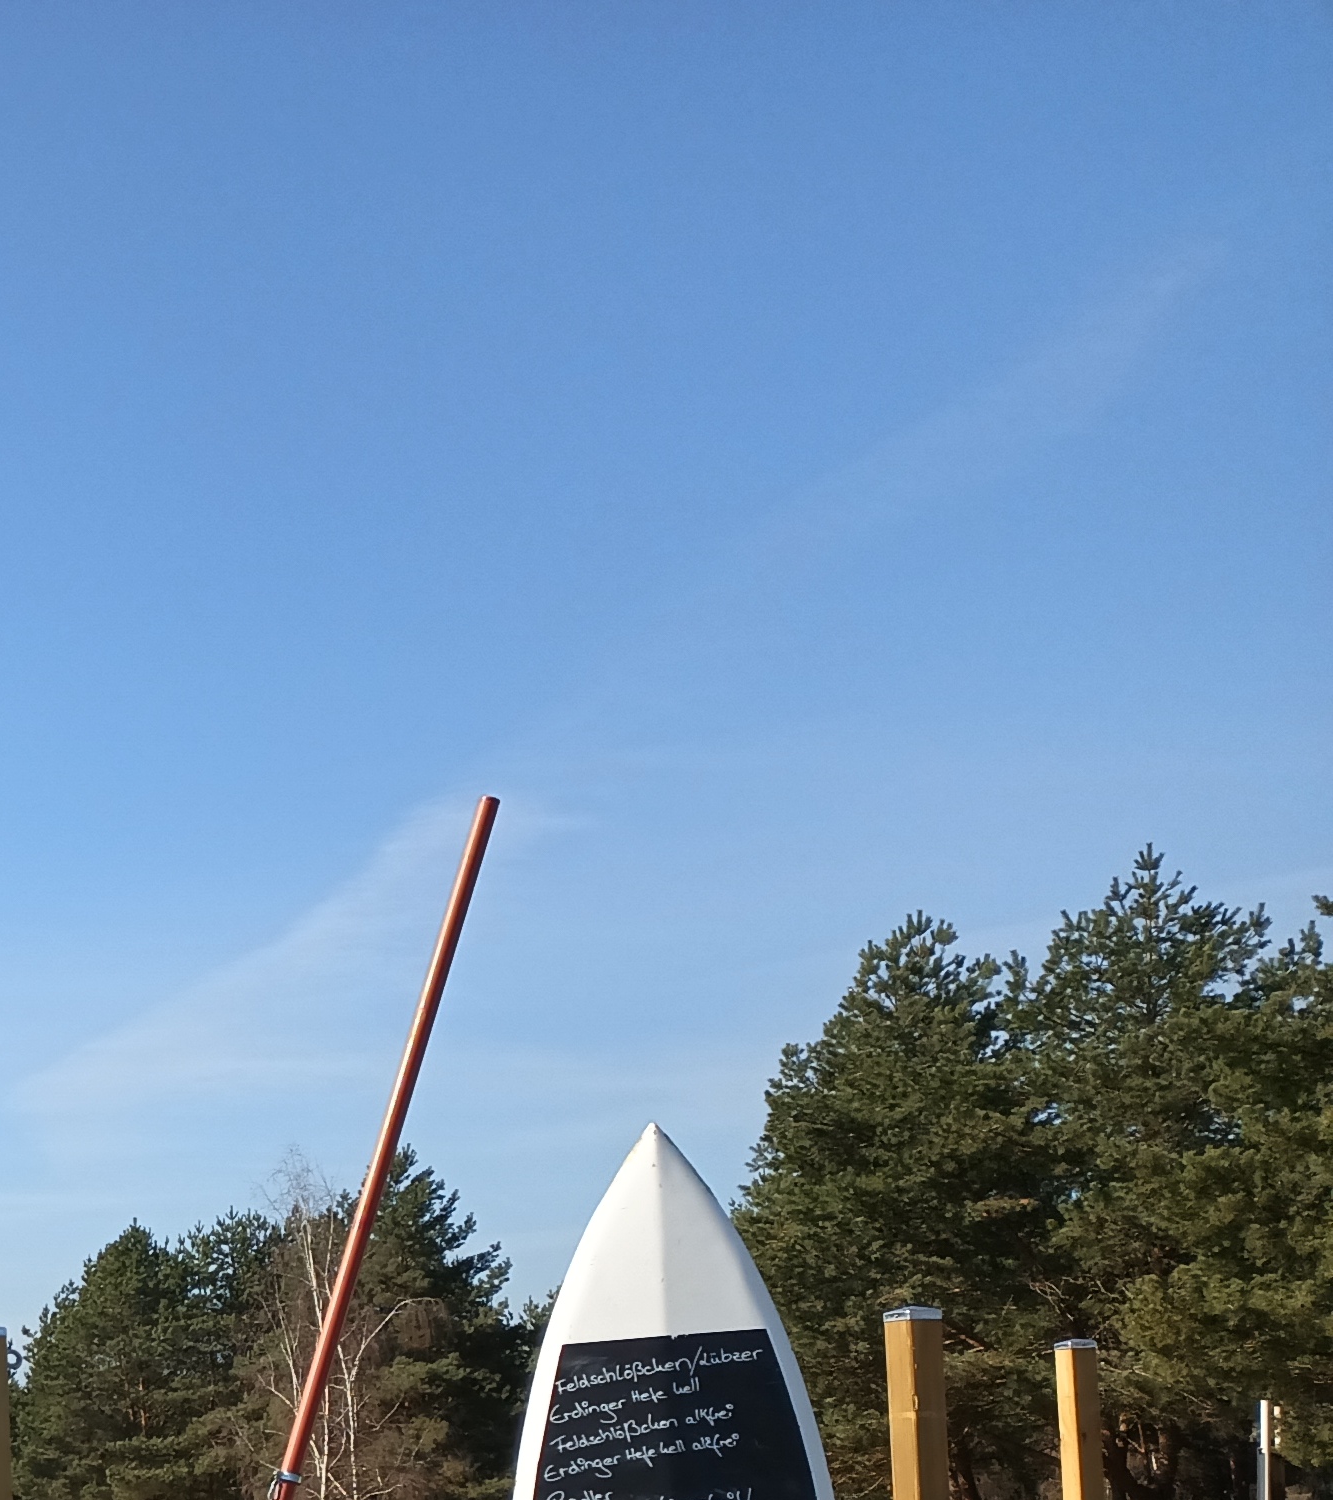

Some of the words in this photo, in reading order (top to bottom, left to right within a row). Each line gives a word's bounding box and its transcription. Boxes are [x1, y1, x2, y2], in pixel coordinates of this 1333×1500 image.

[549, 1399, 626, 1424] Erdinger
[632, 1387, 668, 1403] Hefe
[673, 1376, 700, 1395] hell
[543, 1454, 621, 1482] Erdinger
[625, 1445, 658, 1468] Hefe
[659, 1439, 686, 1455] hell
